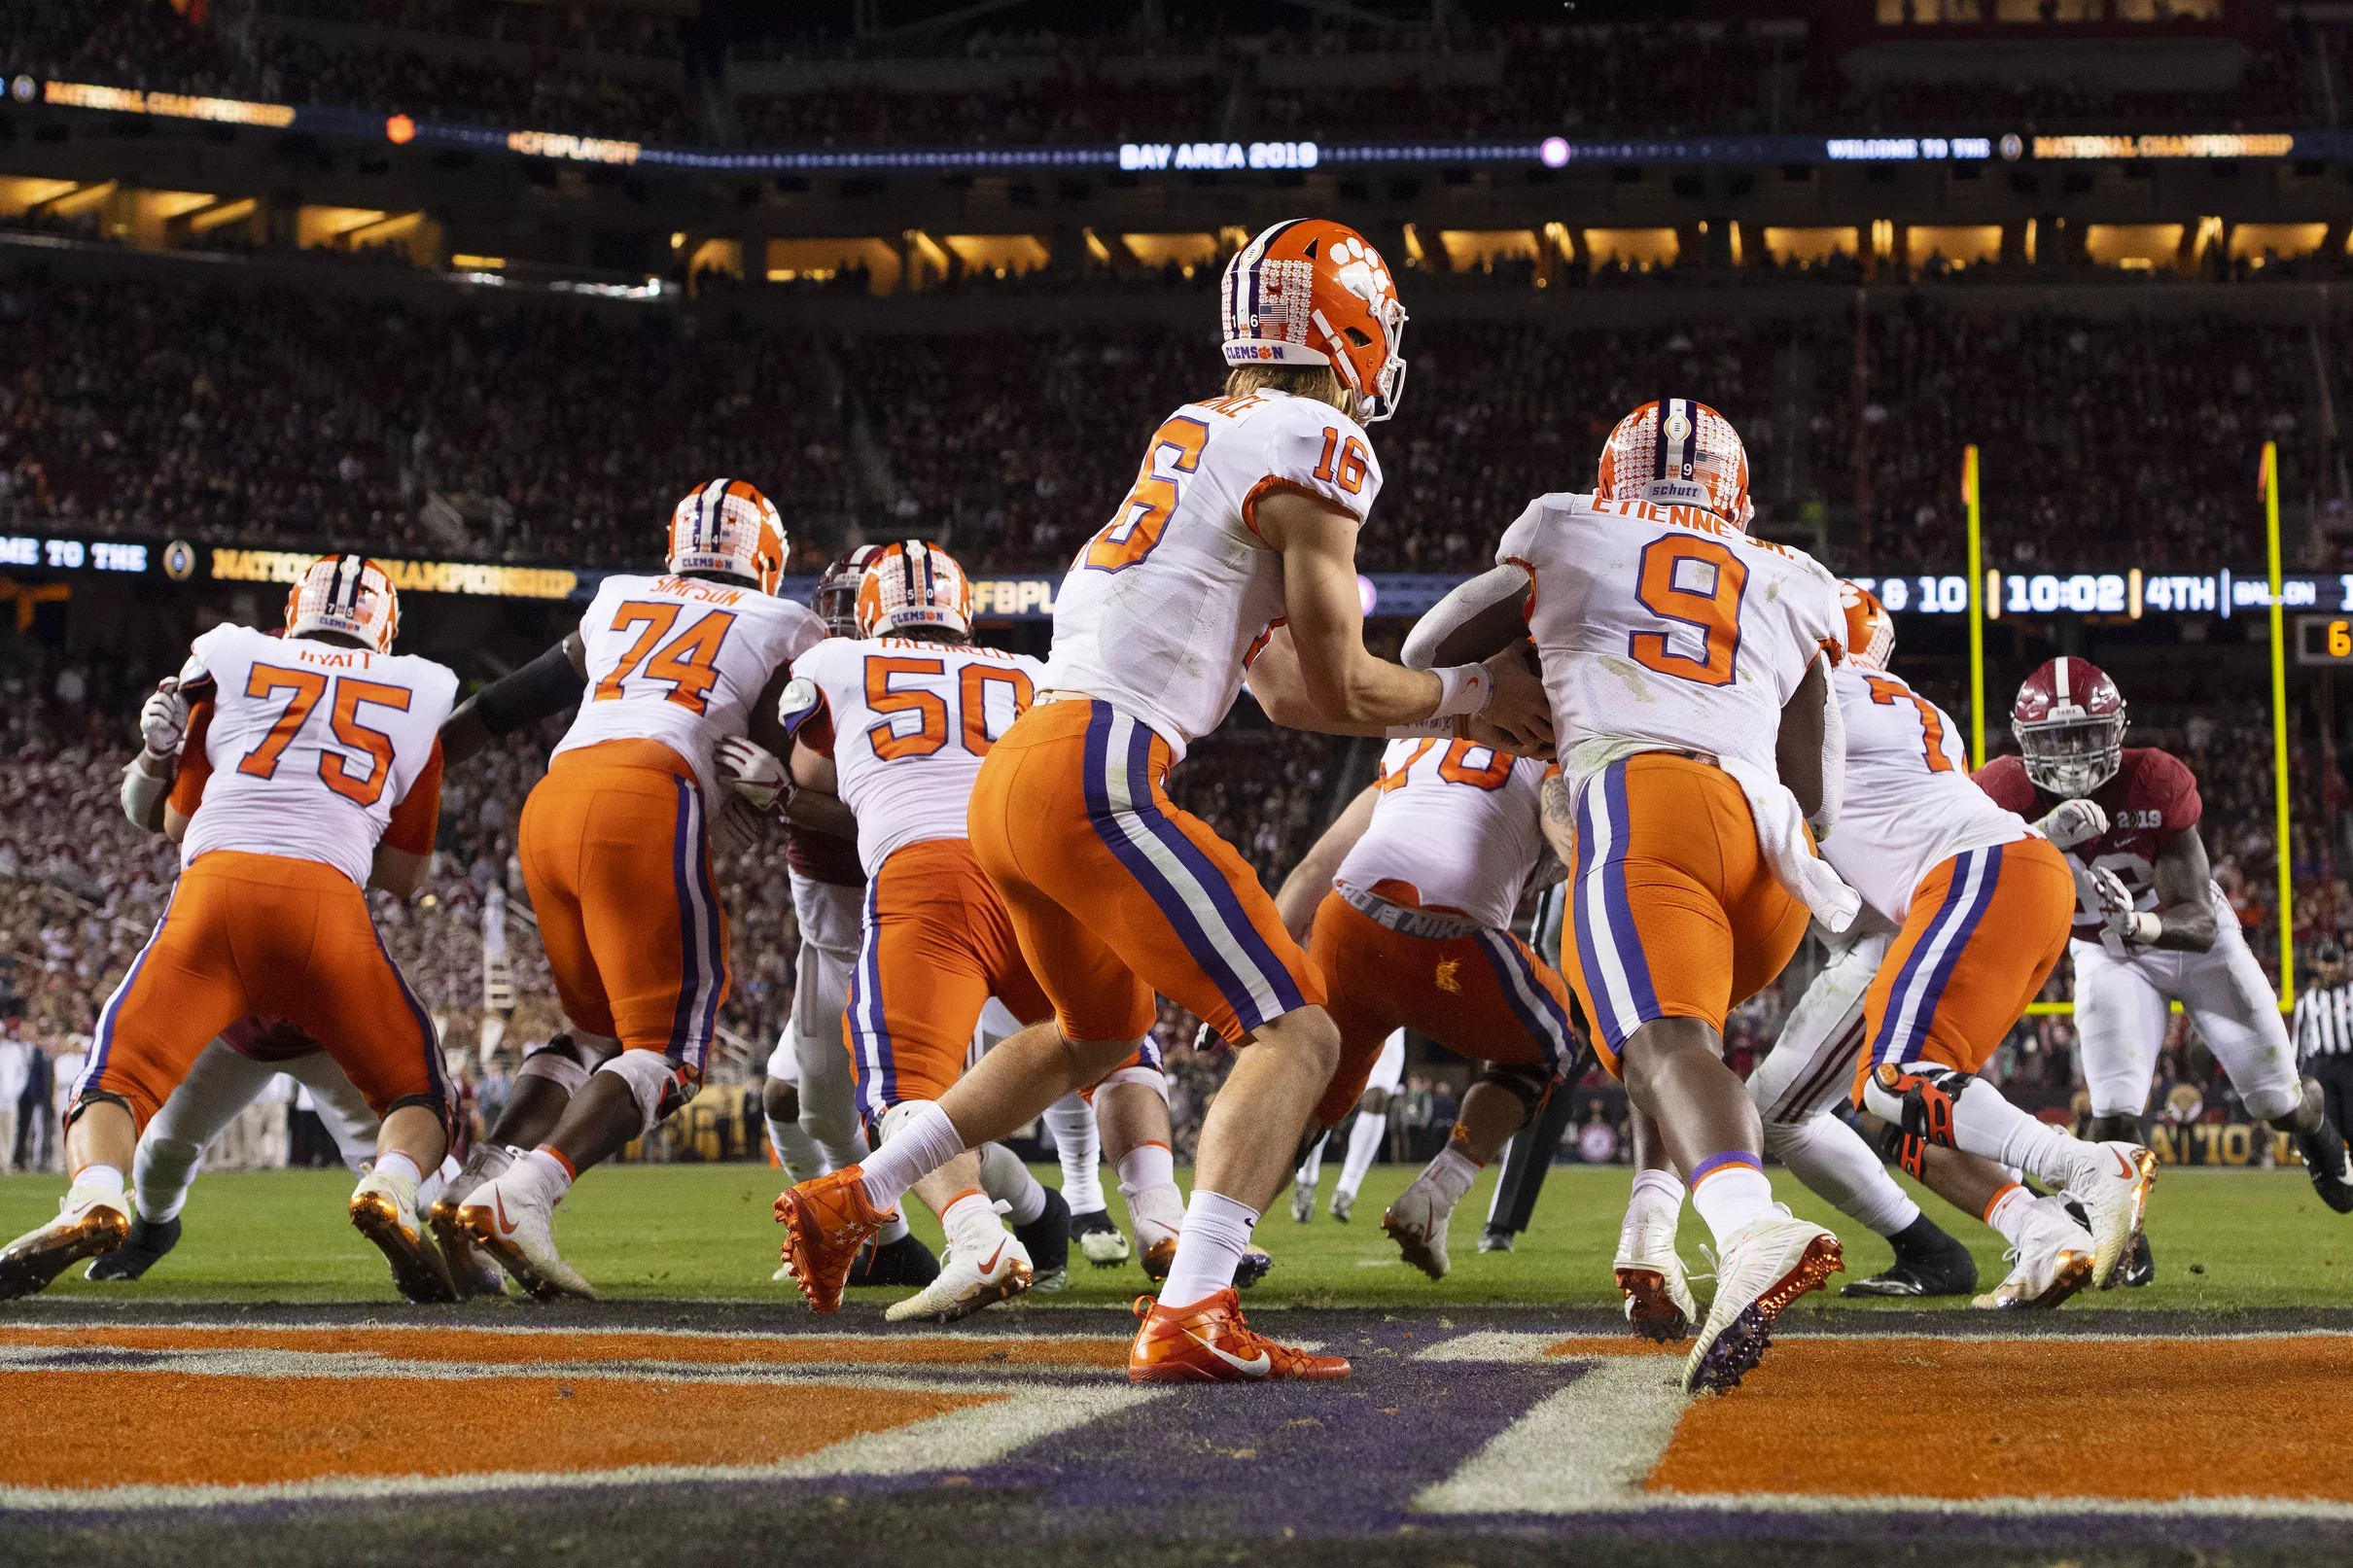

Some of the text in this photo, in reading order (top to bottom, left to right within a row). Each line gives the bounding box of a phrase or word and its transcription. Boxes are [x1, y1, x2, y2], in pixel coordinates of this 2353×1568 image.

[1119, 142, 1317, 170] BAY AREA 2019
[1826, 139, 1917, 159] WELCOME
[1920, 139, 1948, 158] TO
[1950, 138, 1990, 158] THE
[2033, 136, 2138, 158] NATIONAL
[1070, 415, 1211, 575] 6
[1313, 426, 1370, 496] 16
[46, 540, 85, 568] TO
[91, 542, 147, 572] THE
[368, 558, 578, 600] HAMPIONSHIP
[1628, 532, 1750, 688] 9
[1918, 575, 1967, 613] 10
[2007, 574, 2126, 612] 10:02
[2145, 576, 2216, 611] 4TH
[2283, 581, 2316, 606] ON
[593, 600, 739, 717] 74
[863, 654, 1036, 761] 50
[236, 661, 413, 807] 75
[1862, 675, 1970, 778] 7
